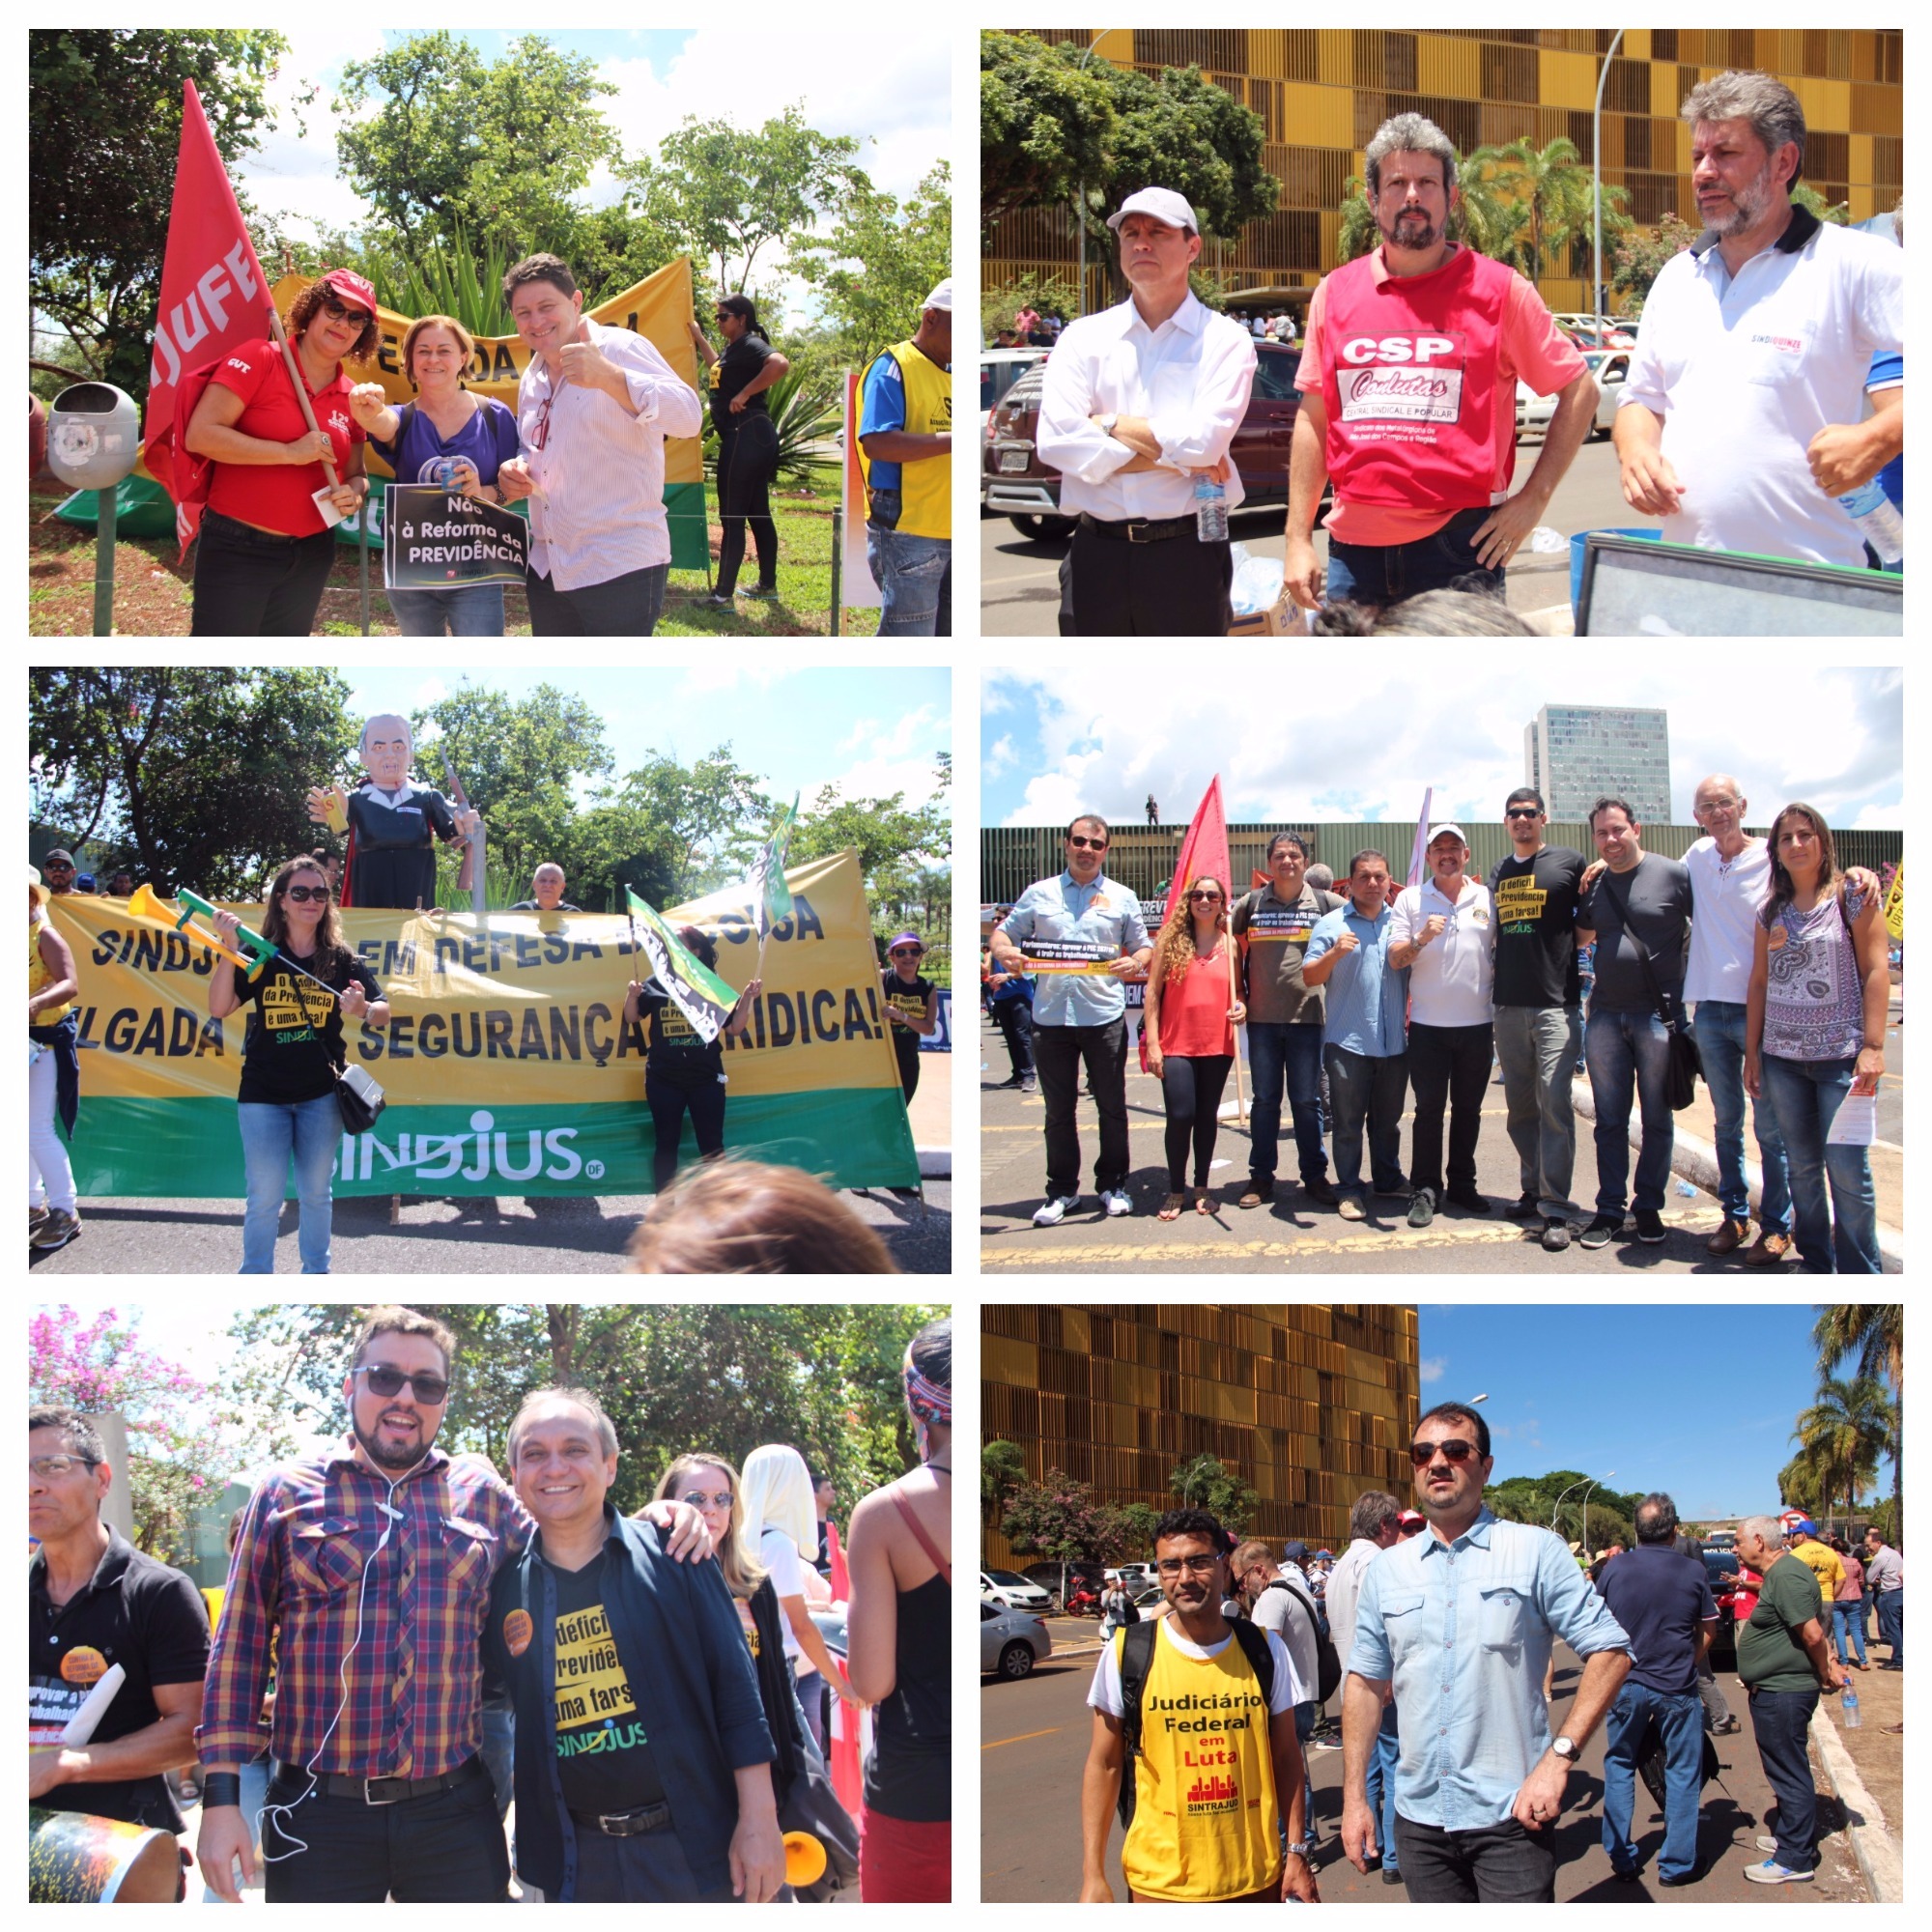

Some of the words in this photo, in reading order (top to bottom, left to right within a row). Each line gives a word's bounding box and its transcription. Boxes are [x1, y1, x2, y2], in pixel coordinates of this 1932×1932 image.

[1342, 336, 1455, 364] CSP
[227, 357, 251, 375] CUT
[1350, 370, 1448, 403] Conlutas
[1371, 406, 1404, 415] SINDICAL
[1406, 407, 1412, 415] E
[1413, 408, 1454, 418] POPULAR
[1382, 432, 1408, 441] Campos
[447, 496, 483, 515] Não
[402, 521, 414, 538] à
[421, 520, 497, 539] Reforma
[501, 532, 523, 550] da
[409, 539, 525, 567] PREVIDÊNCIA
[1507, 878, 1532, 890] déficit
[1500, 891, 1545, 903] Previdência
[1515, 904, 1539, 918] farsa!
[265, 989, 277, 1002] da
[268, 1011, 274, 1025] é
[276, 1011, 298, 1025] uma
[357, 1002, 649, 1067] SEGURANÇA
[328, 1110, 582, 1181] INDJUS
[586, 1164, 602, 1177] DF
[555, 1609, 609, 1646] défici
[589, 1684, 635, 1713] fars
[1149, 1692, 1263, 1712] Judiciário
[1164, 1713, 1251, 1733] Federal
[555, 1719, 648, 1757] SINDJUS
[1199, 1737, 1225, 1747] em
[1184, 1750, 1237, 1767] Luta
[1187, 1799, 1238, 1812] SINTRAJUD
